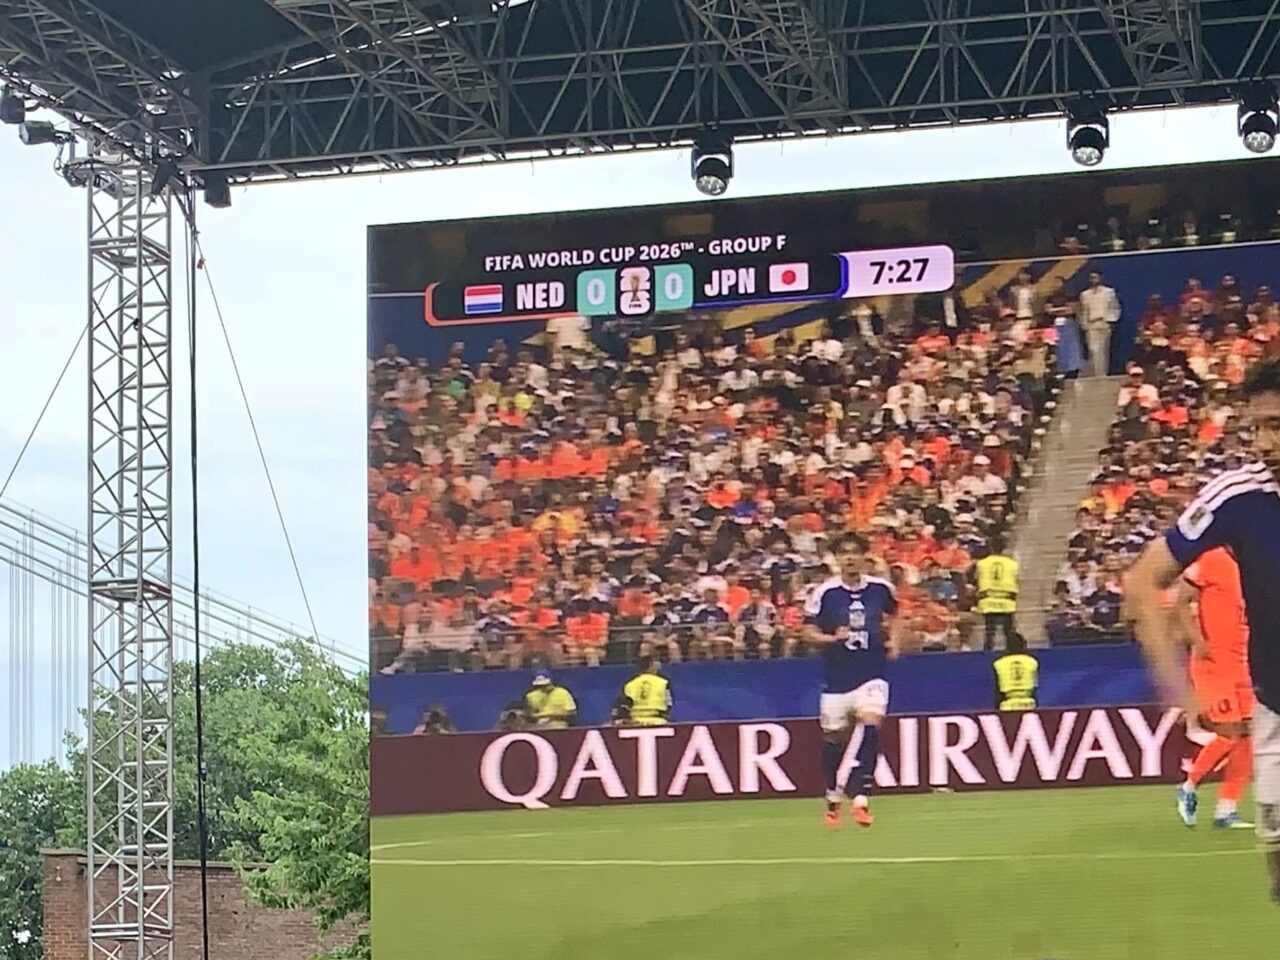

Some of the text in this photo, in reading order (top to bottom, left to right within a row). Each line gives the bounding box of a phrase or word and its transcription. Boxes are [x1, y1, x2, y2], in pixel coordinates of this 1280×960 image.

[484, 254, 525, 272] FIFA
[528, 250, 594, 269] WORLD
[599, 246, 635, 263] CUP
[708, 238, 769, 256] GROUP
[776, 235, 787, 250] F
[664, 267, 756, 300] 0 JPN
[869, 257, 930, 285] 7:27
[516, 278, 606, 310] NED 0
[479, 707, 1228, 810] QATAR AIRWAY
